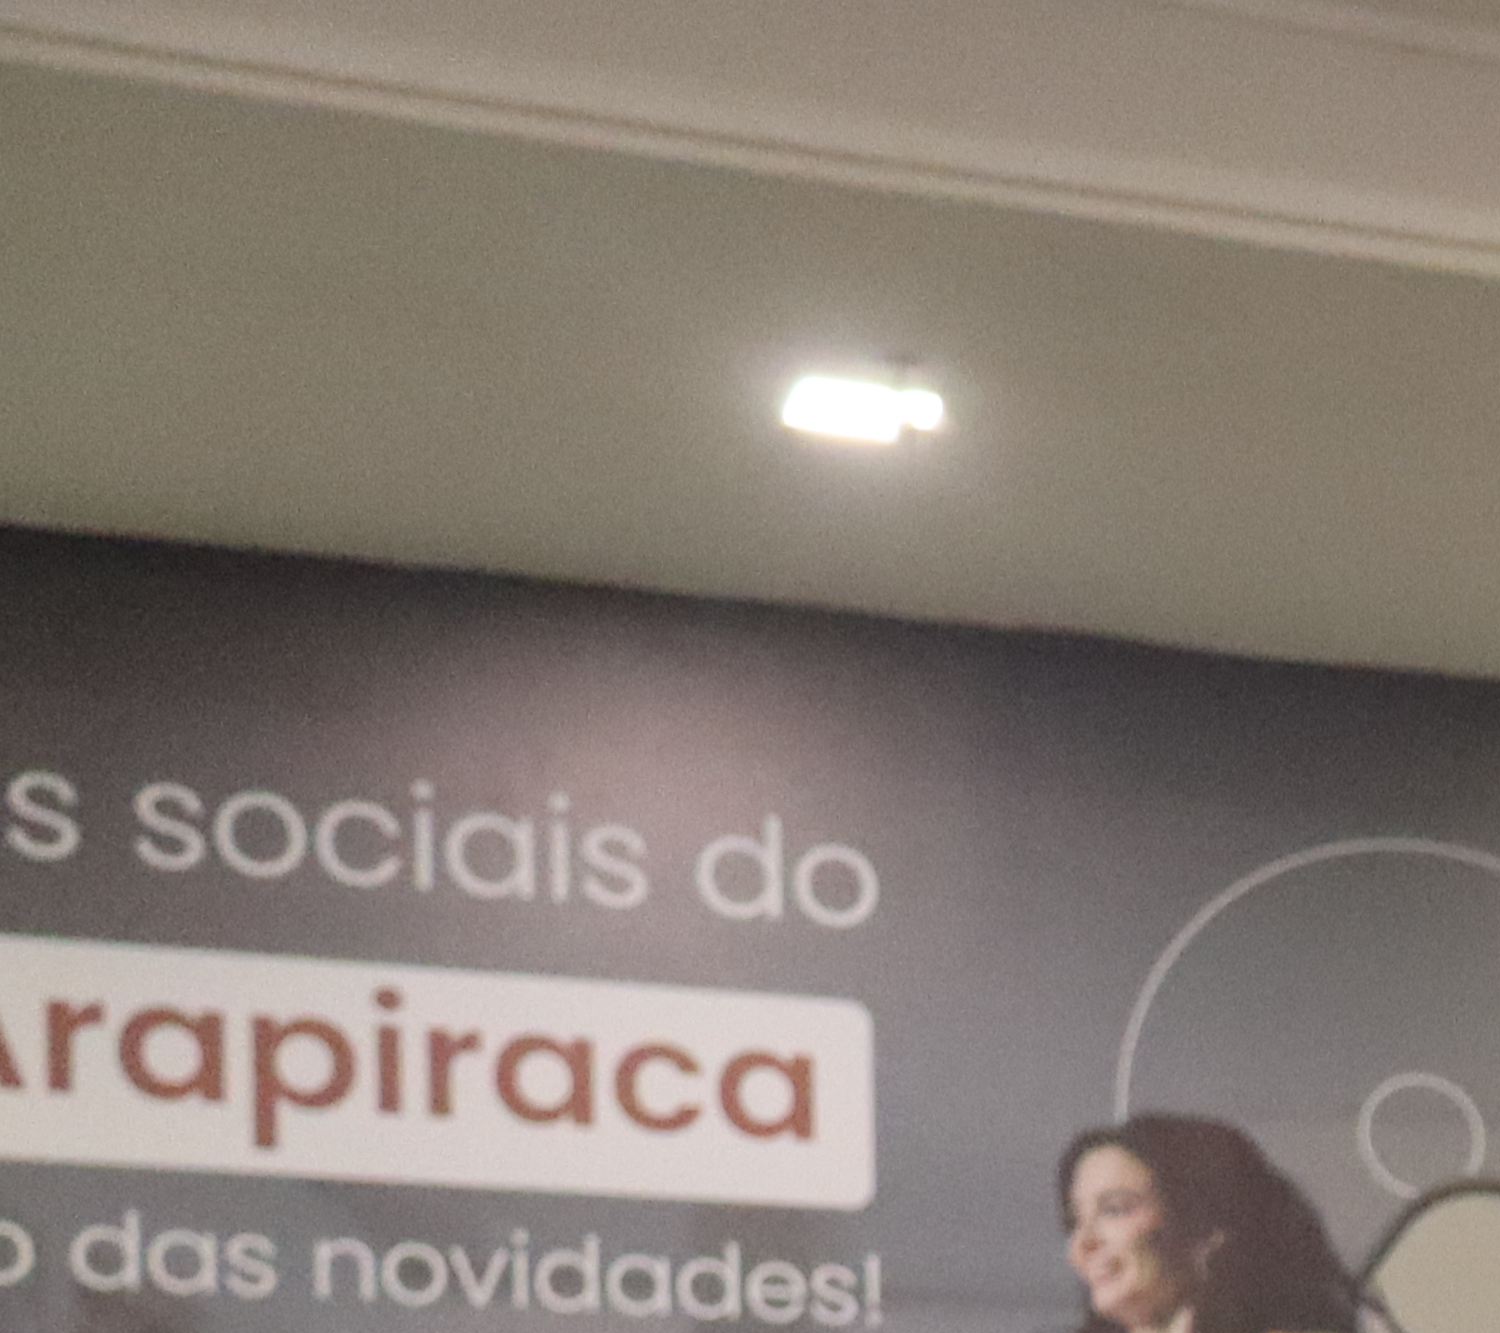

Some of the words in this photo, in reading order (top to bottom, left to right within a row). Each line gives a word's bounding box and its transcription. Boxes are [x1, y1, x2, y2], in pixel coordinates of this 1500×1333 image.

[133, 778, 650, 910] sociais
[694, 813, 880, 929] do
[69, 1209, 278, 1300] das
[312, 1227, 885, 1328] novidades!
